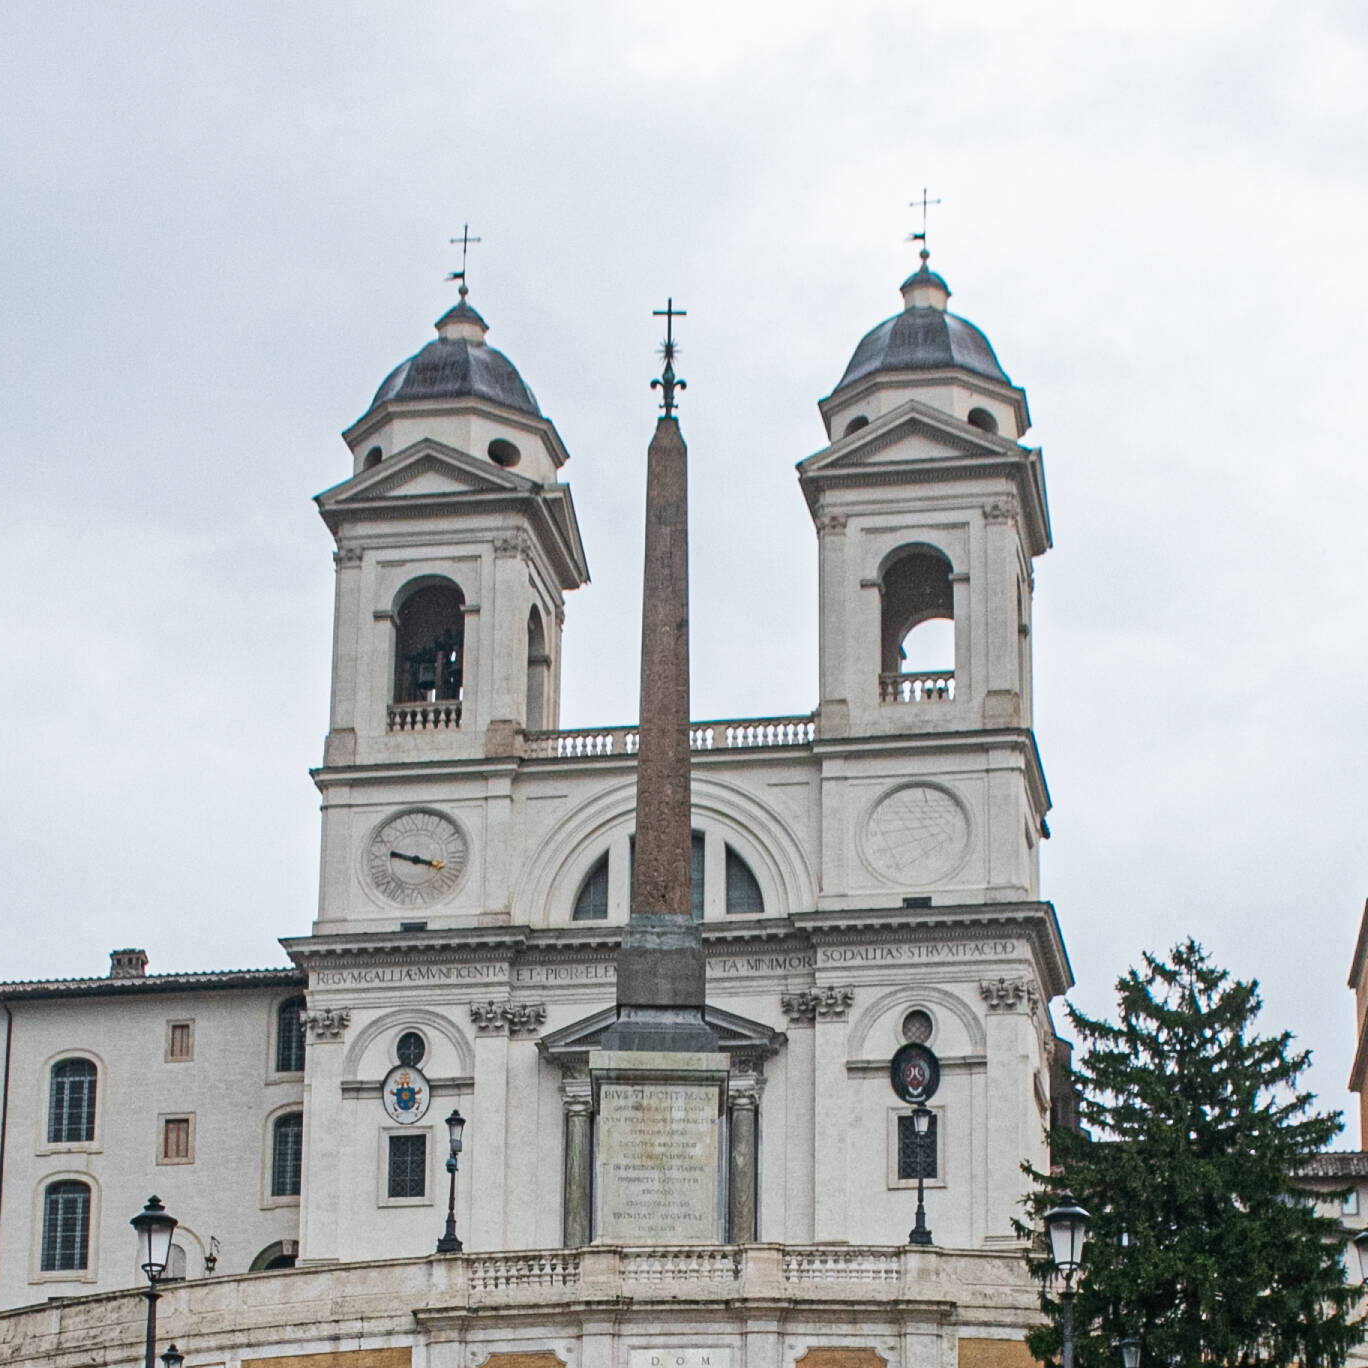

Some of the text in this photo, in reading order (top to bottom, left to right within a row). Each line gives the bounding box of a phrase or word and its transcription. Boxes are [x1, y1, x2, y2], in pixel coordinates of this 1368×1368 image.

[516, 967, 537, 982] ET
[822, 947, 903, 962] SODALITAS
[907, 943, 968, 959] STRVXIT
